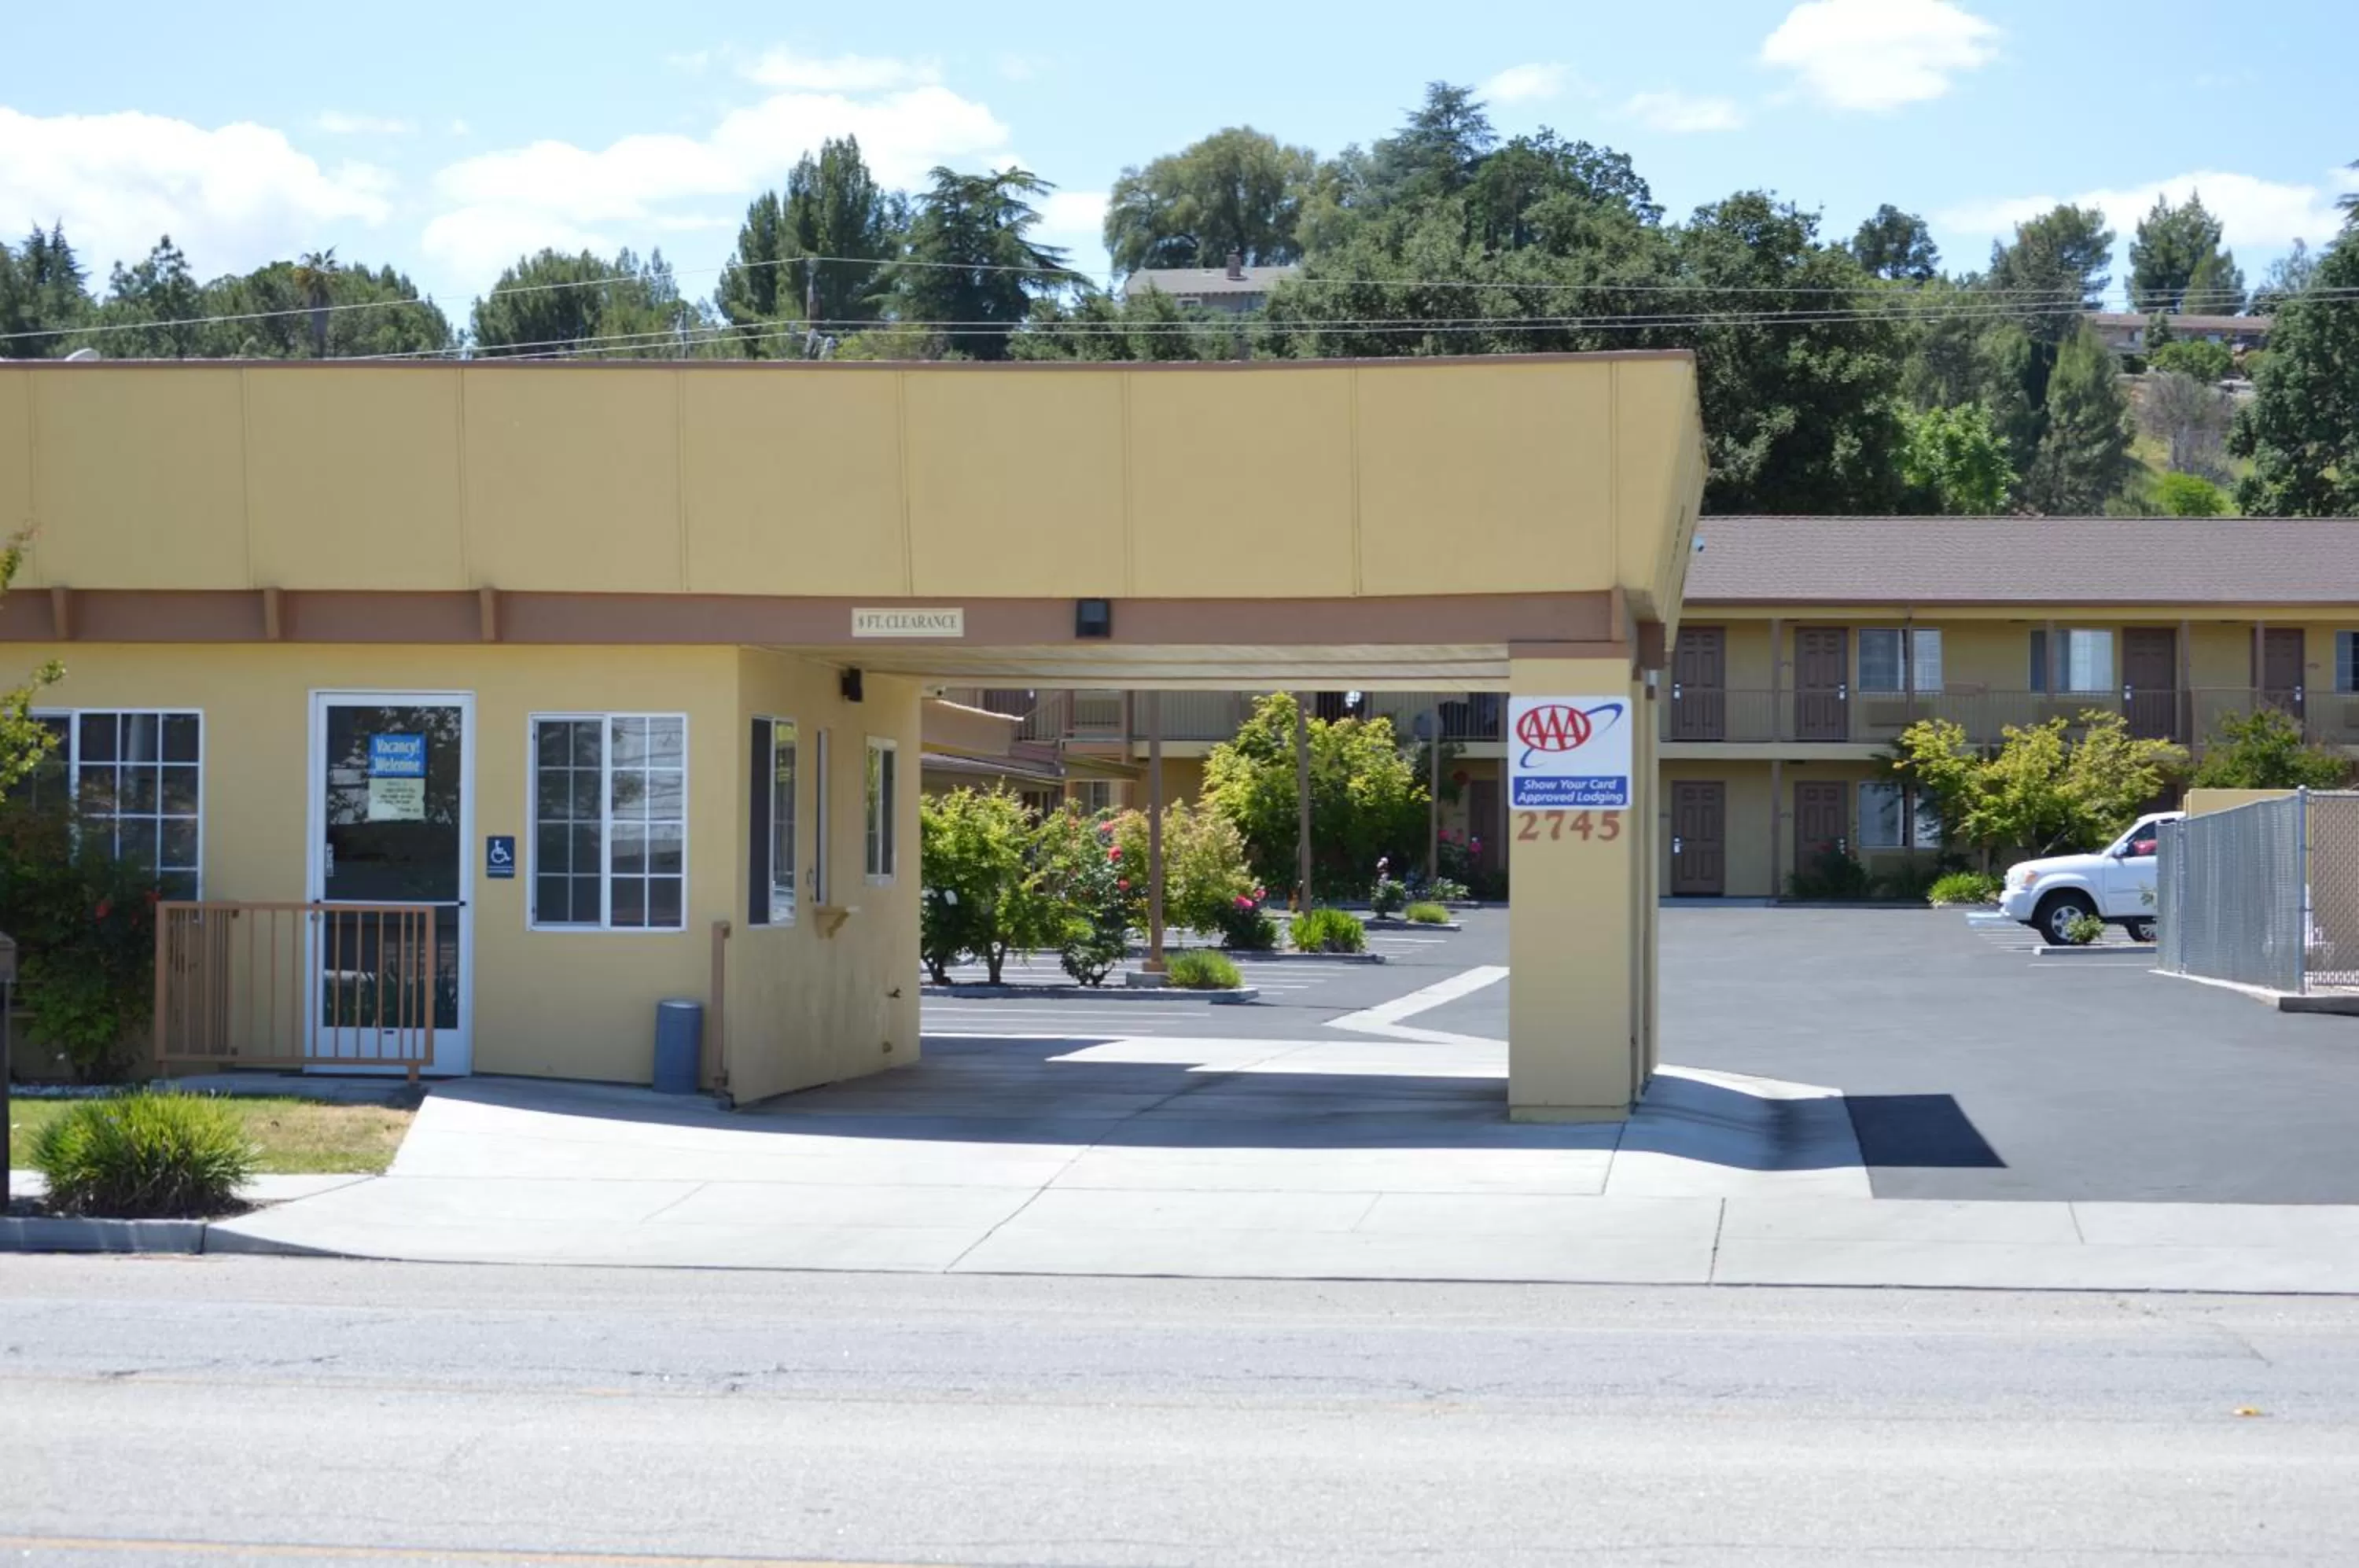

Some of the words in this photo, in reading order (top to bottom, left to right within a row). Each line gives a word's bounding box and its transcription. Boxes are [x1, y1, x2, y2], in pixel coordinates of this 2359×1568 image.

[885, 614, 956, 628] CLEARANCE
[1522, 705, 1587, 751] AAA
[1523, 779, 1558, 790] Show
[1560, 779, 1587, 790] Your
[1589, 778, 1617, 790] Card
[1518, 792, 1573, 804] Approved
[1577, 792, 1624, 804] Lodging
[1517, 810, 1621, 841] 2745
